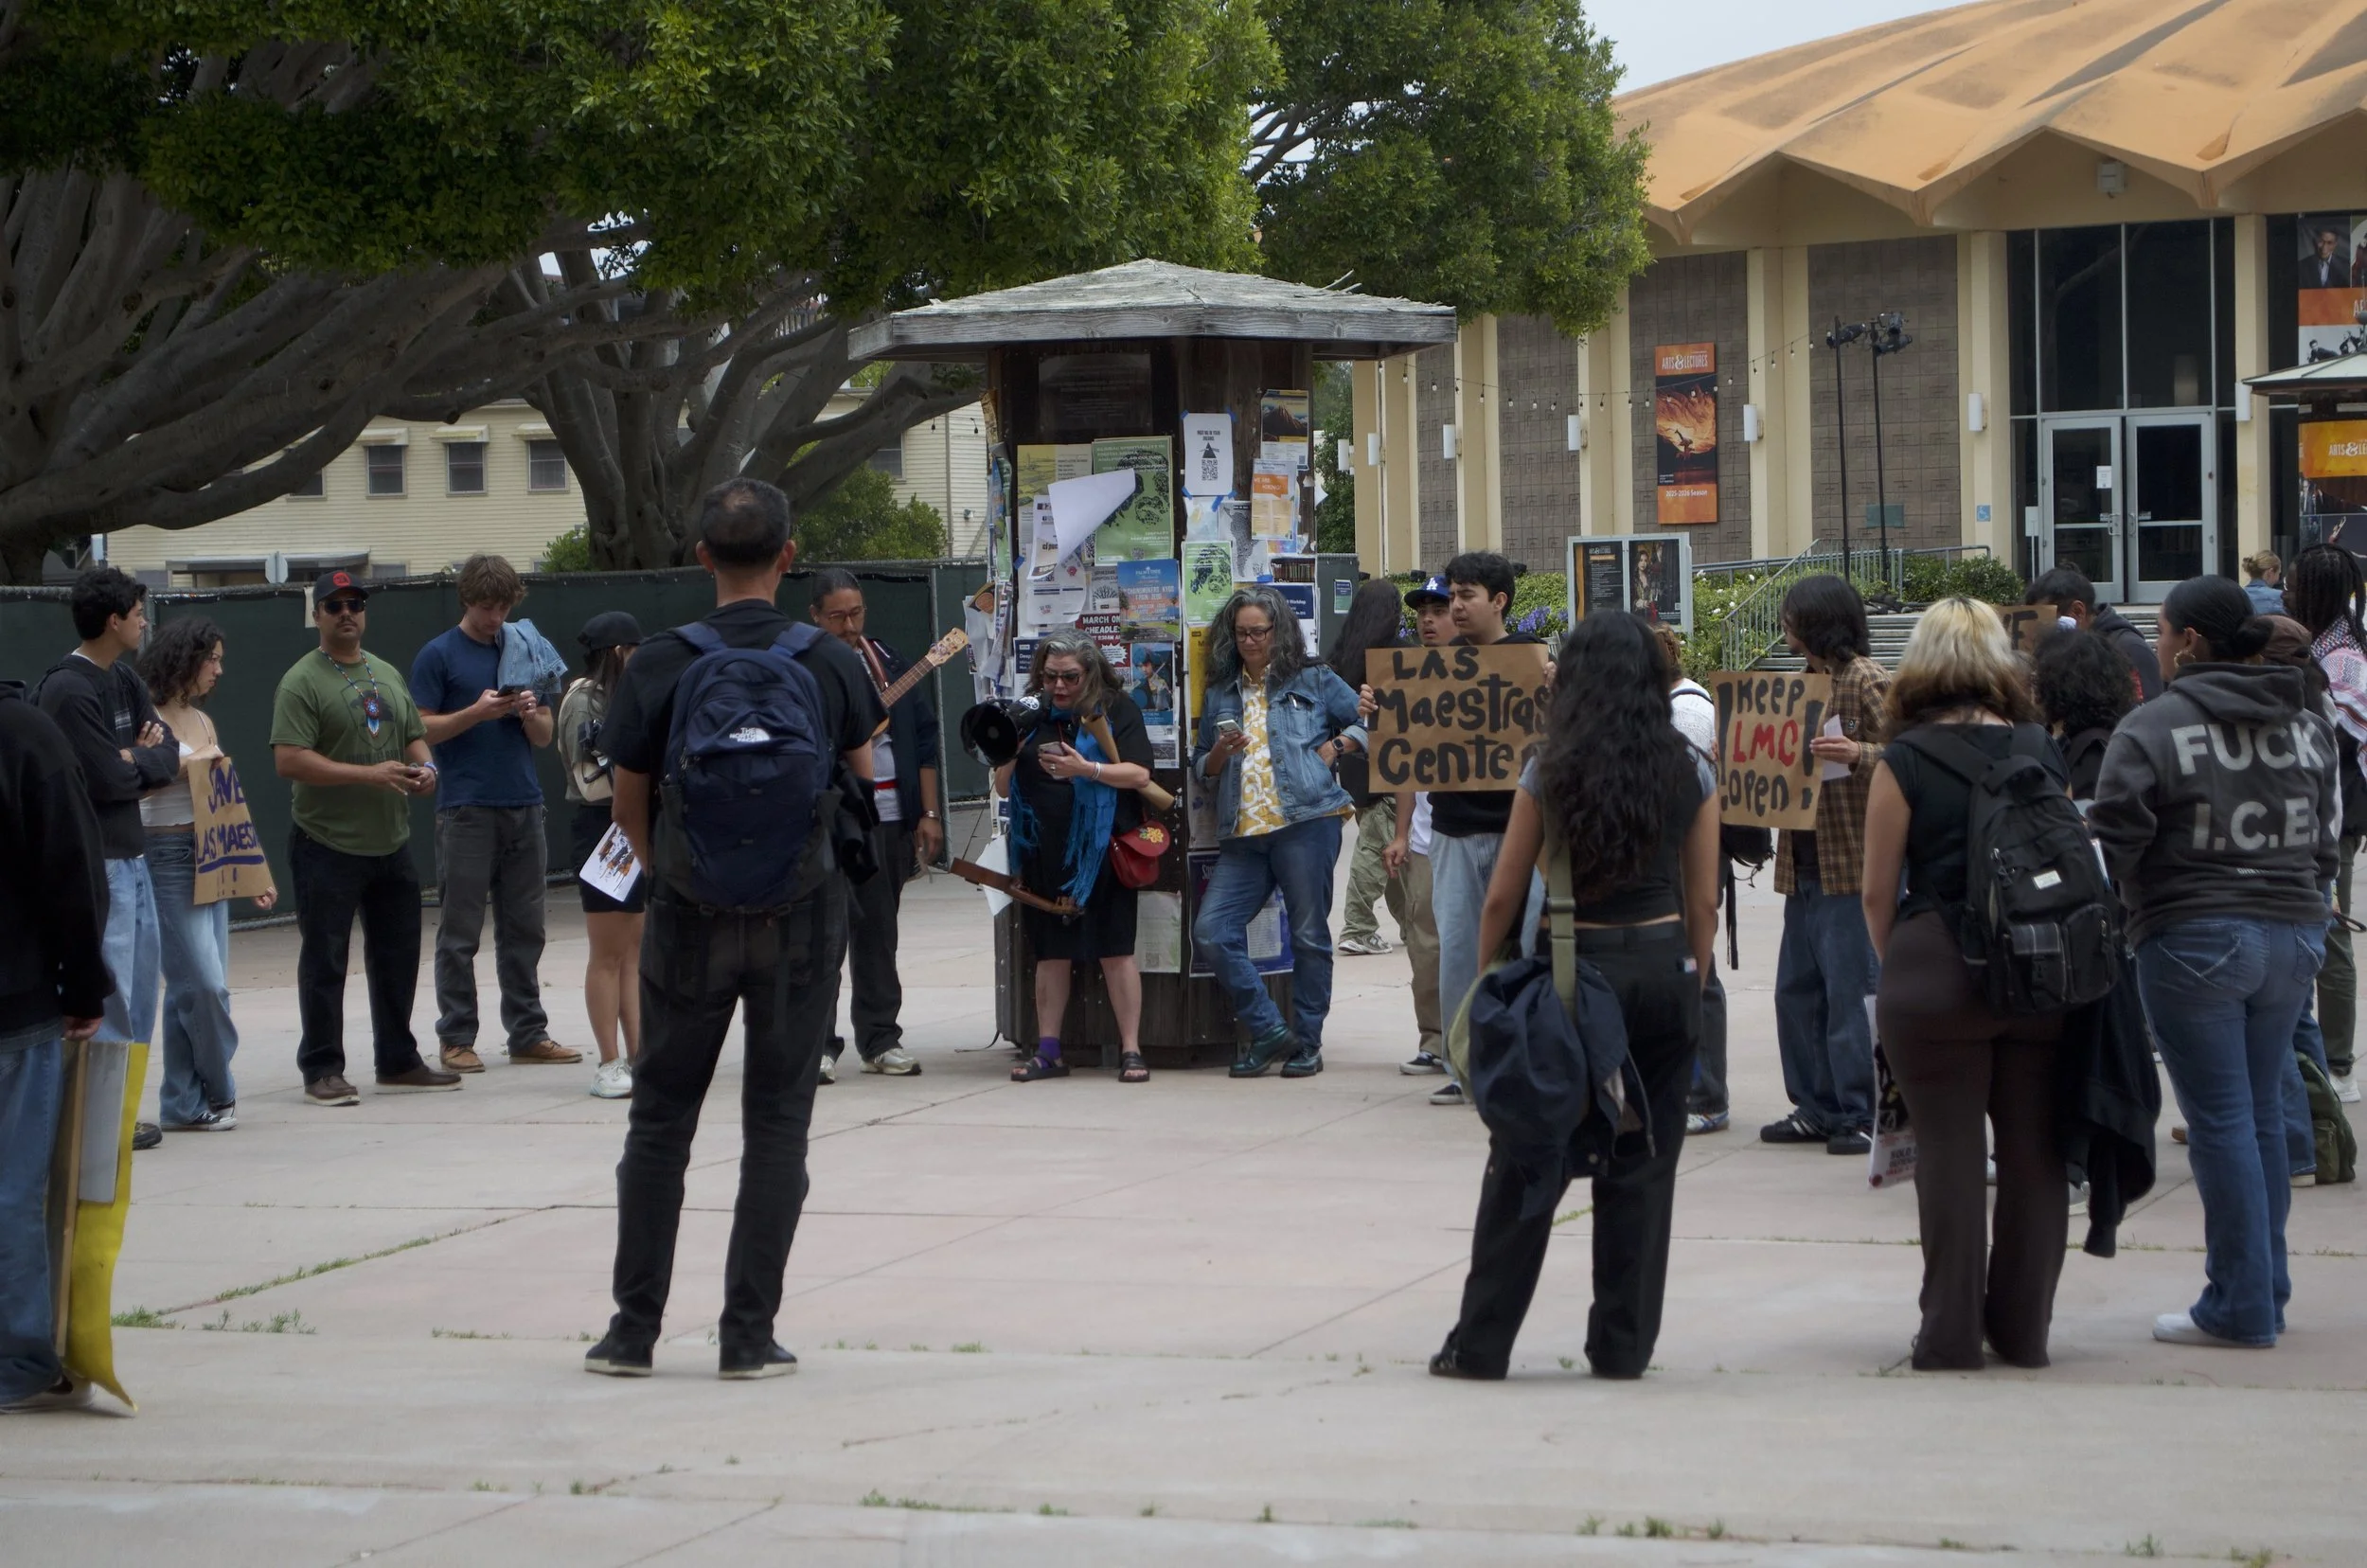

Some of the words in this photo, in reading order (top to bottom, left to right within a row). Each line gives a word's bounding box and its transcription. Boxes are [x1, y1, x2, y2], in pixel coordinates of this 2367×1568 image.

[1393, 647, 1480, 681] LAS
[1733, 720, 1799, 767] LMC
[2170, 722, 2325, 775] FUCK
[208, 764, 247, 814] SAVE
[195, 827, 217, 864] LAS
[2193, 796, 2318, 851] I.C.E.
